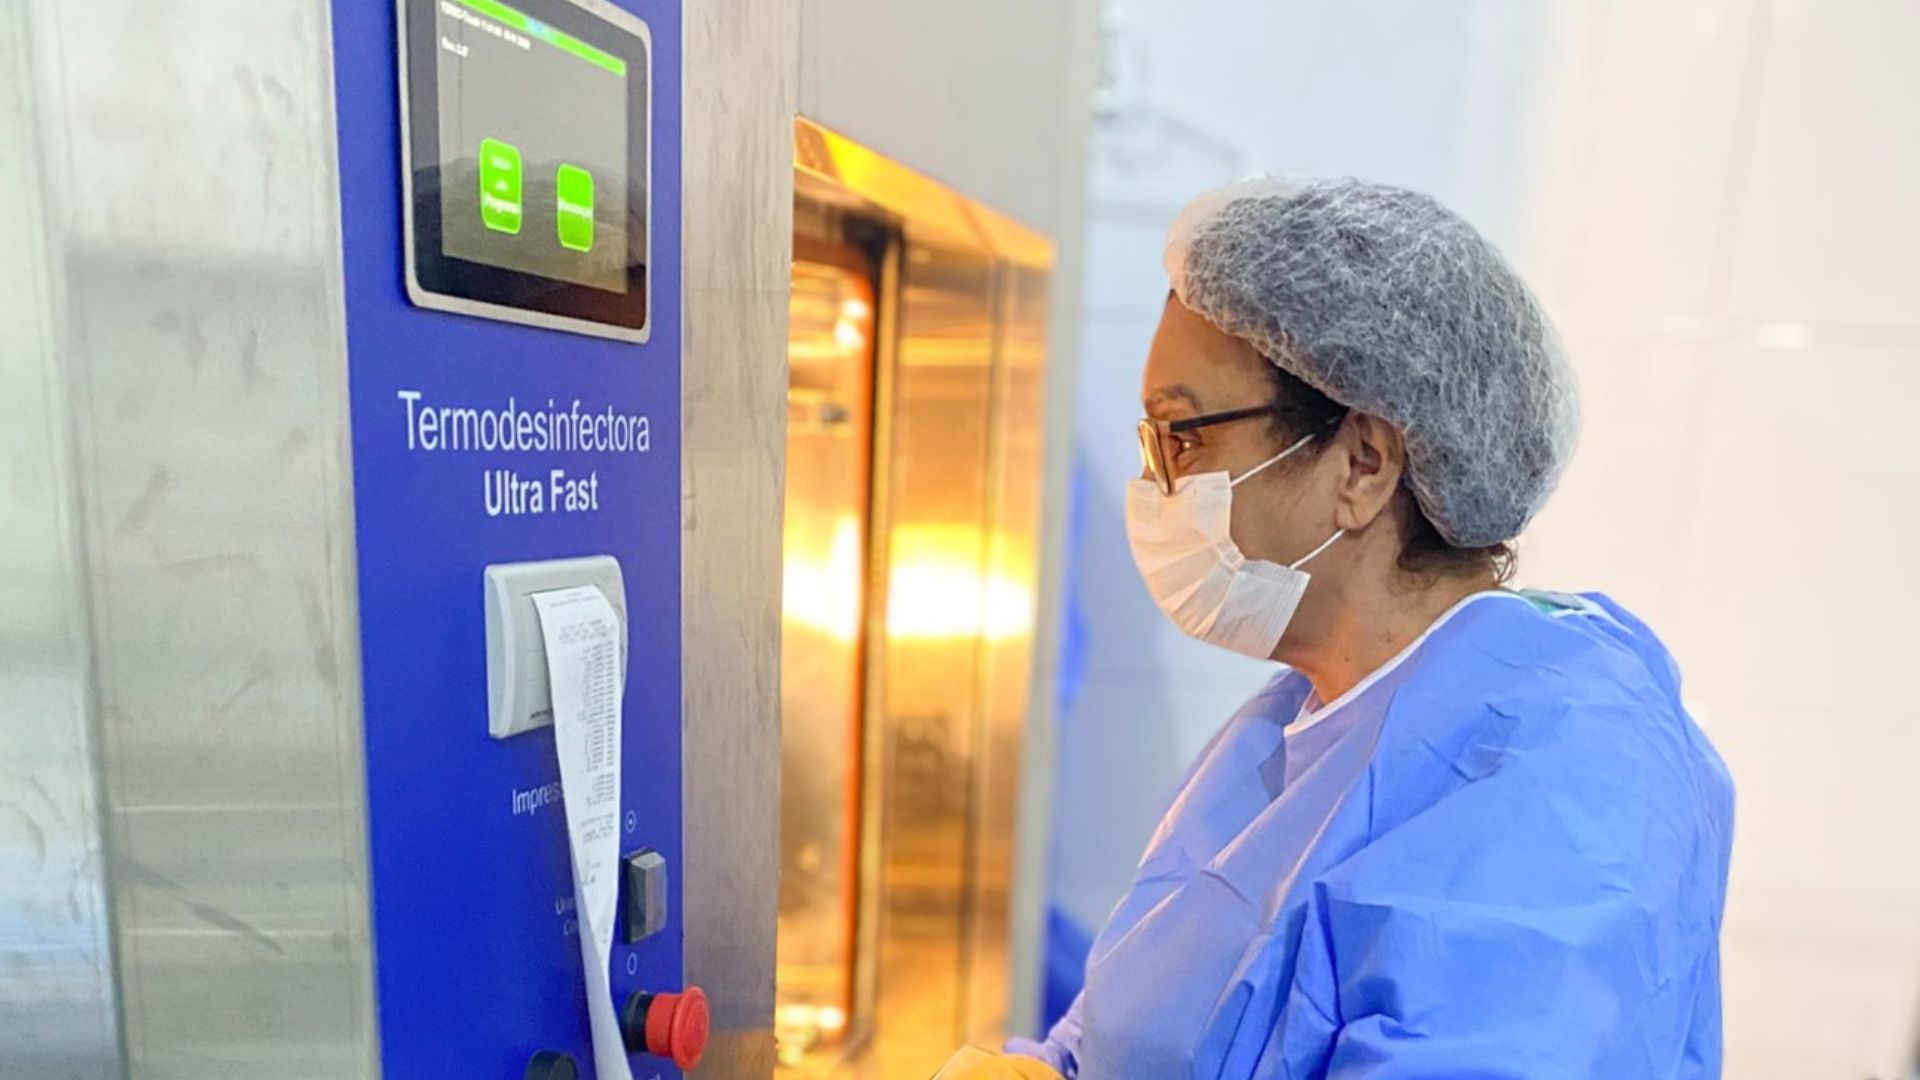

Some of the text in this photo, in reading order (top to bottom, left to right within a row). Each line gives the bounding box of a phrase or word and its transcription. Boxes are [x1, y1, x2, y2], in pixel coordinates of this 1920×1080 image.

[397, 389, 650, 452] Termodesinfectora
[484, 469, 598, 516] Ultra Fast
[512, 782, 563, 816] Impres
